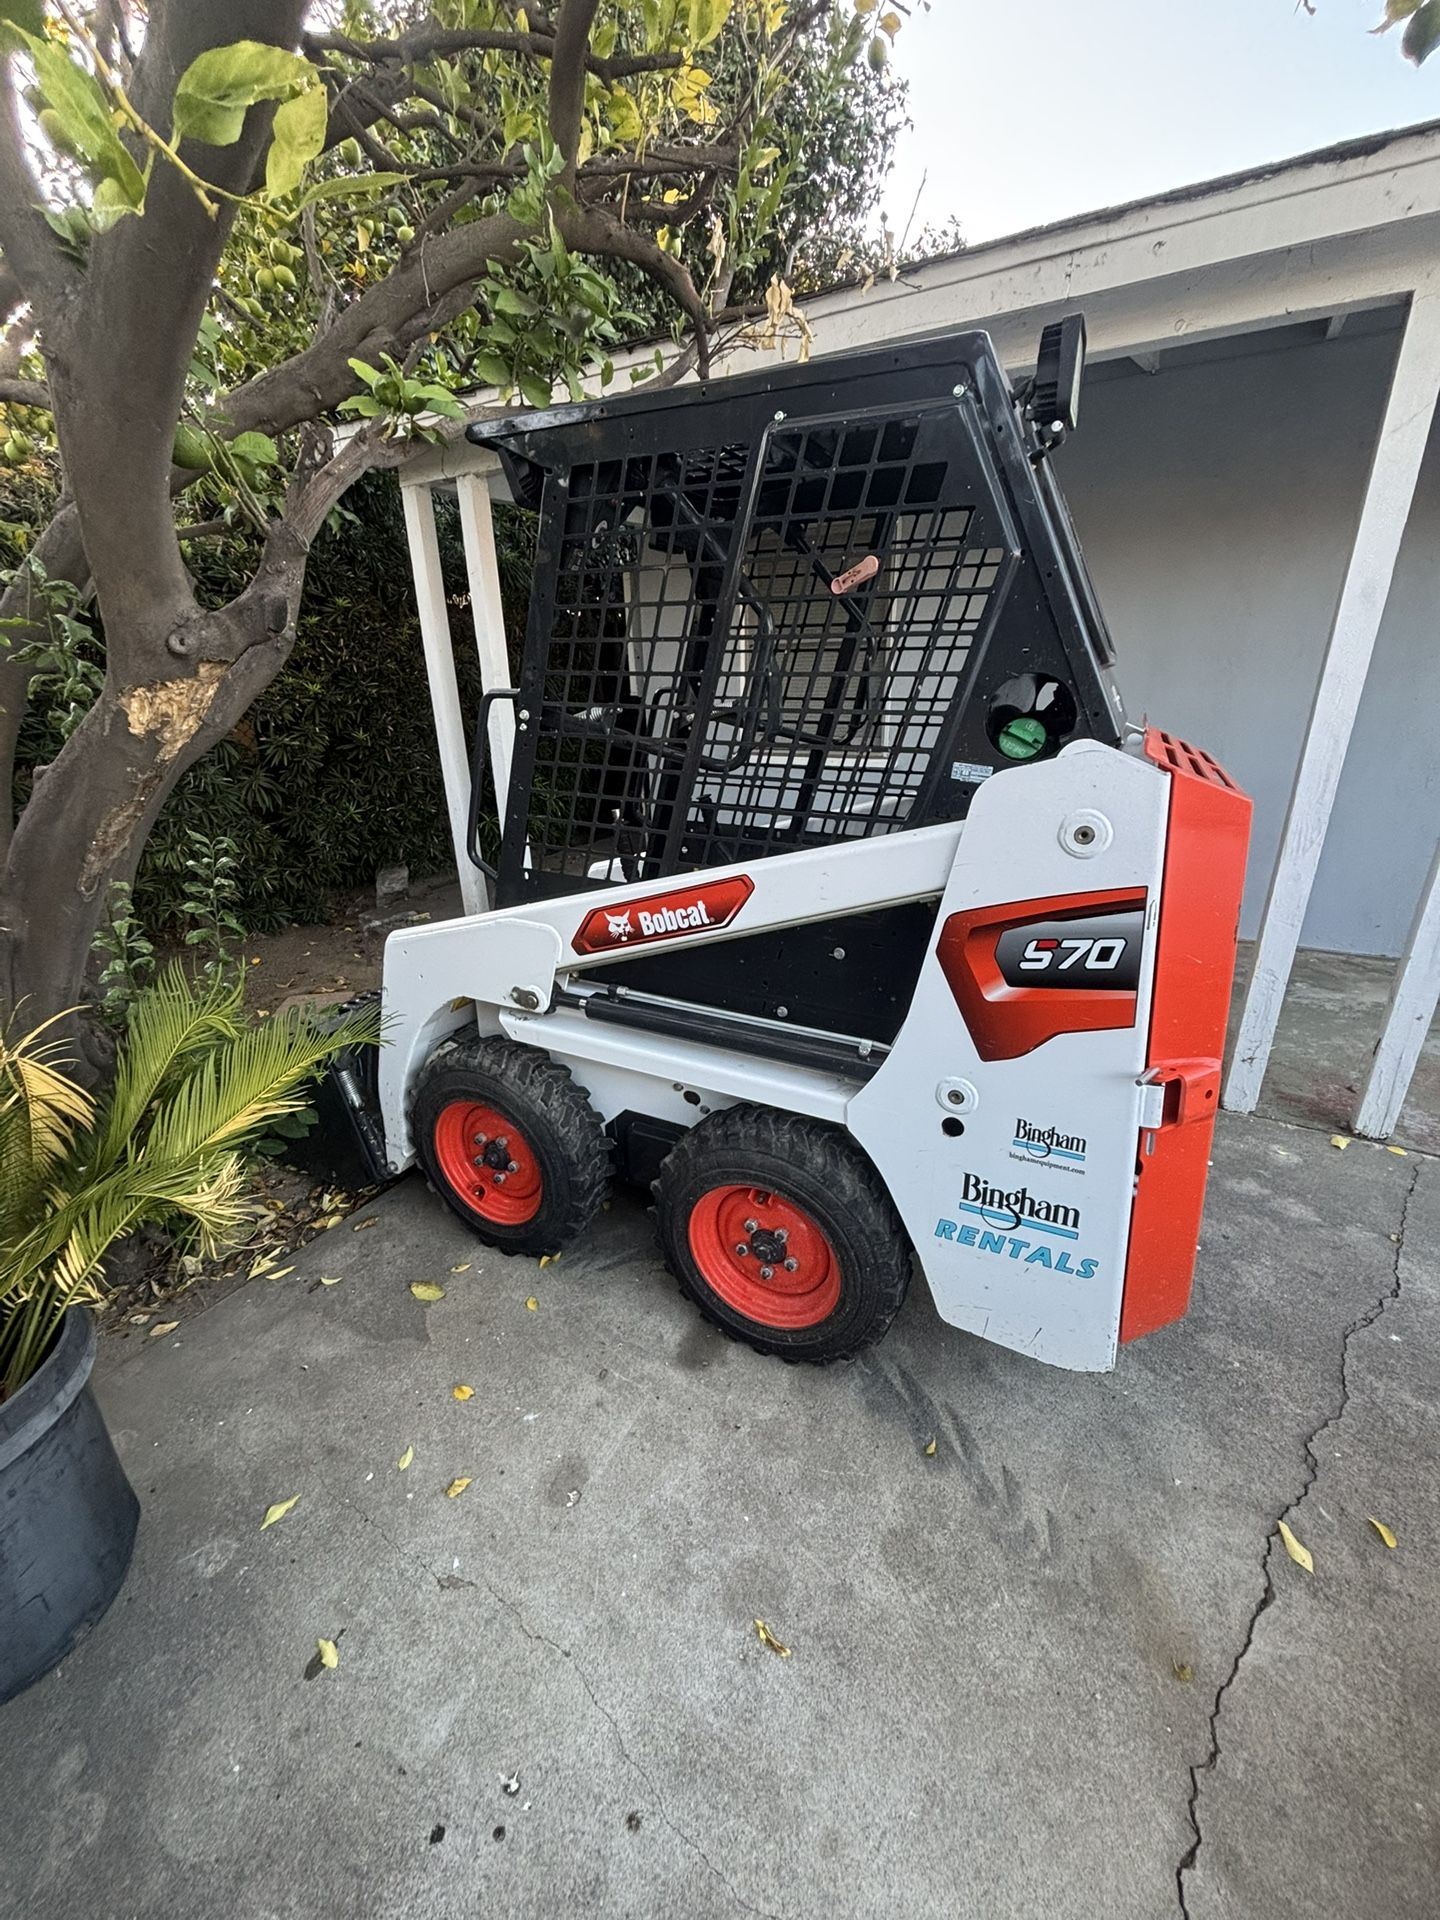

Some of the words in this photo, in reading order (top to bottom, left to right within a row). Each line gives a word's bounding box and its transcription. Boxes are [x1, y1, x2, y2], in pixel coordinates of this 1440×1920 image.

[638, 900, 710, 936] Bobcat
[1019, 938, 1127, 970] S70
[1014, 1118, 1087, 1158] Bingham
[1008, 1151, 1086, 1176] binghamequipment.com
[960, 1172, 1081, 1231] Bingham
[934, 1218, 1099, 1279] RENTALS
